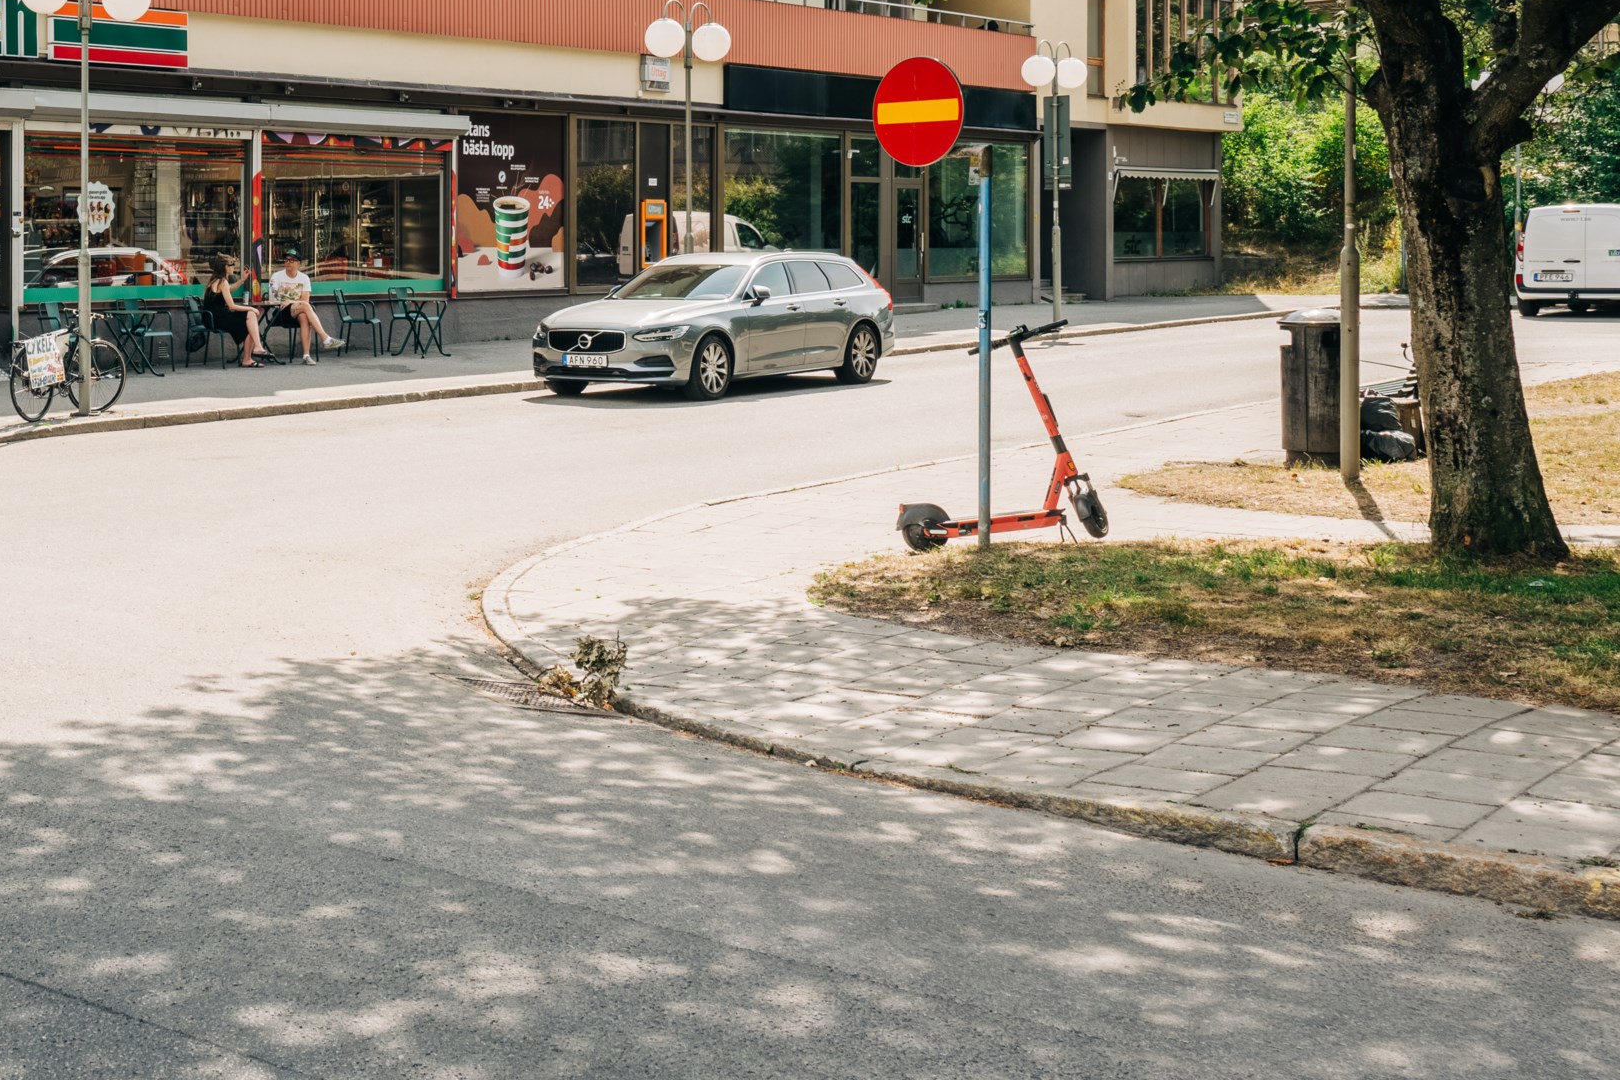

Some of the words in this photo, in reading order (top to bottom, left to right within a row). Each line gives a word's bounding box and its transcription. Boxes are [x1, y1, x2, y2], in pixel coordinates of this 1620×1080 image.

[651, 66, 667, 80] Uttag
[465, 121, 490, 137] tans
[463, 139, 490, 156] bästa
[491, 141, 515, 160] kopp
[538, 195, 555, 209] 24:-
[1540, 273, 1553, 281] PFE
[1555, 273, 1570, 281] 946
[569, 355, 585, 365] AFN
[586, 356, 603, 365] 960
